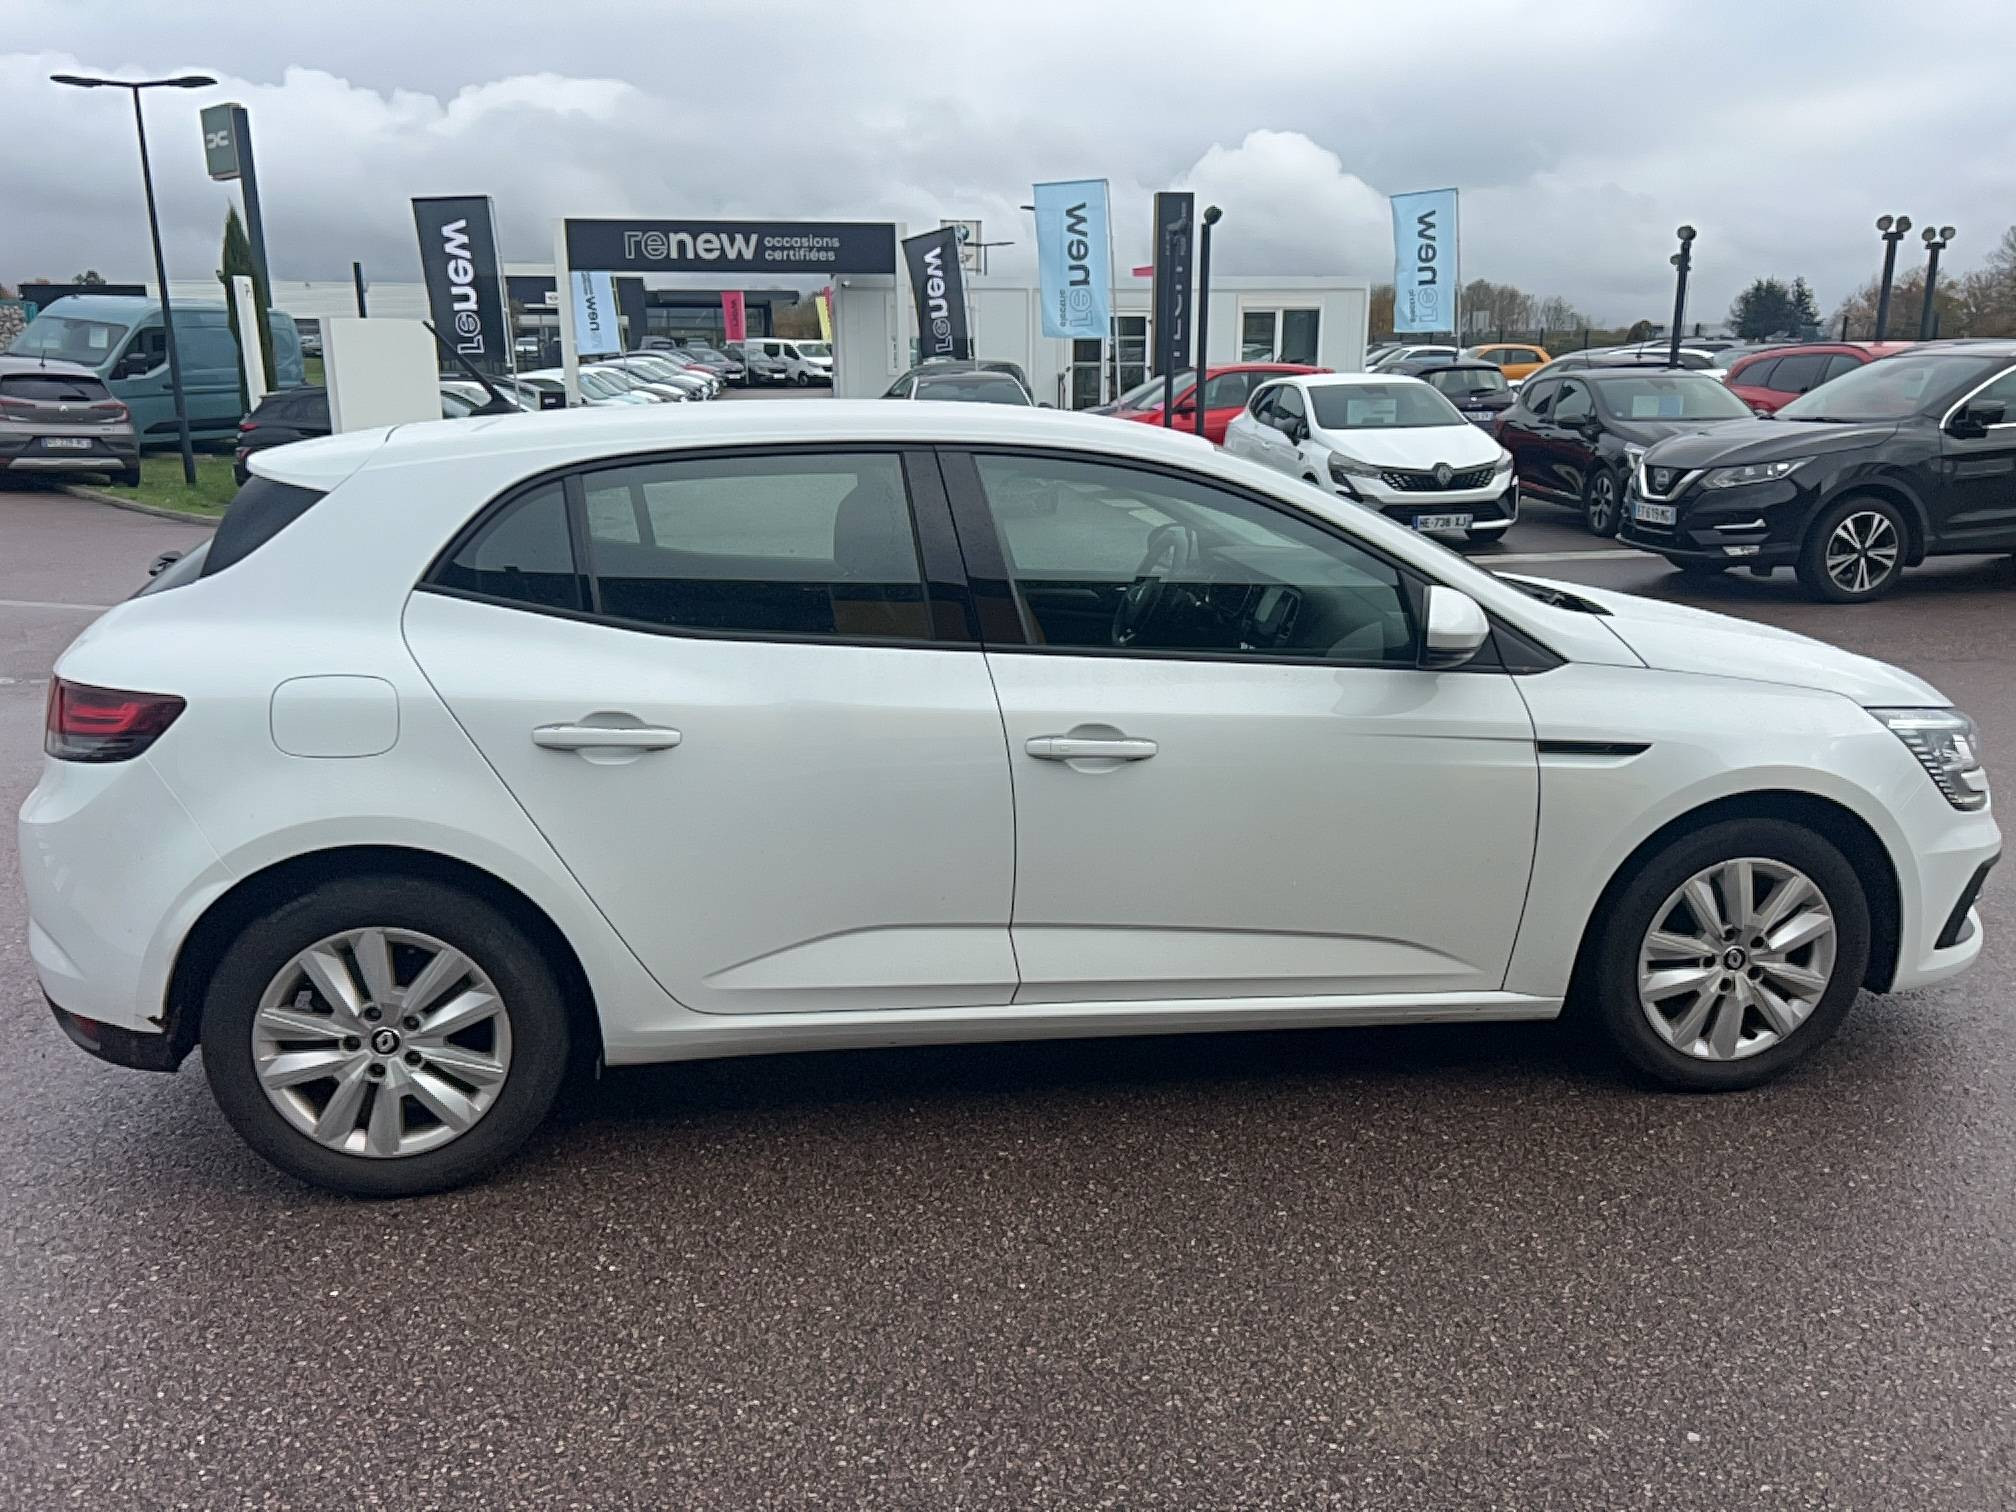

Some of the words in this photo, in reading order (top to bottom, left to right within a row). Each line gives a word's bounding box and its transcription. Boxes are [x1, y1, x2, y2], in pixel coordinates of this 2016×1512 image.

[623, 231, 759, 260] renew
[763, 234, 841, 248] occasions
[764, 248, 837, 261] certifiées
